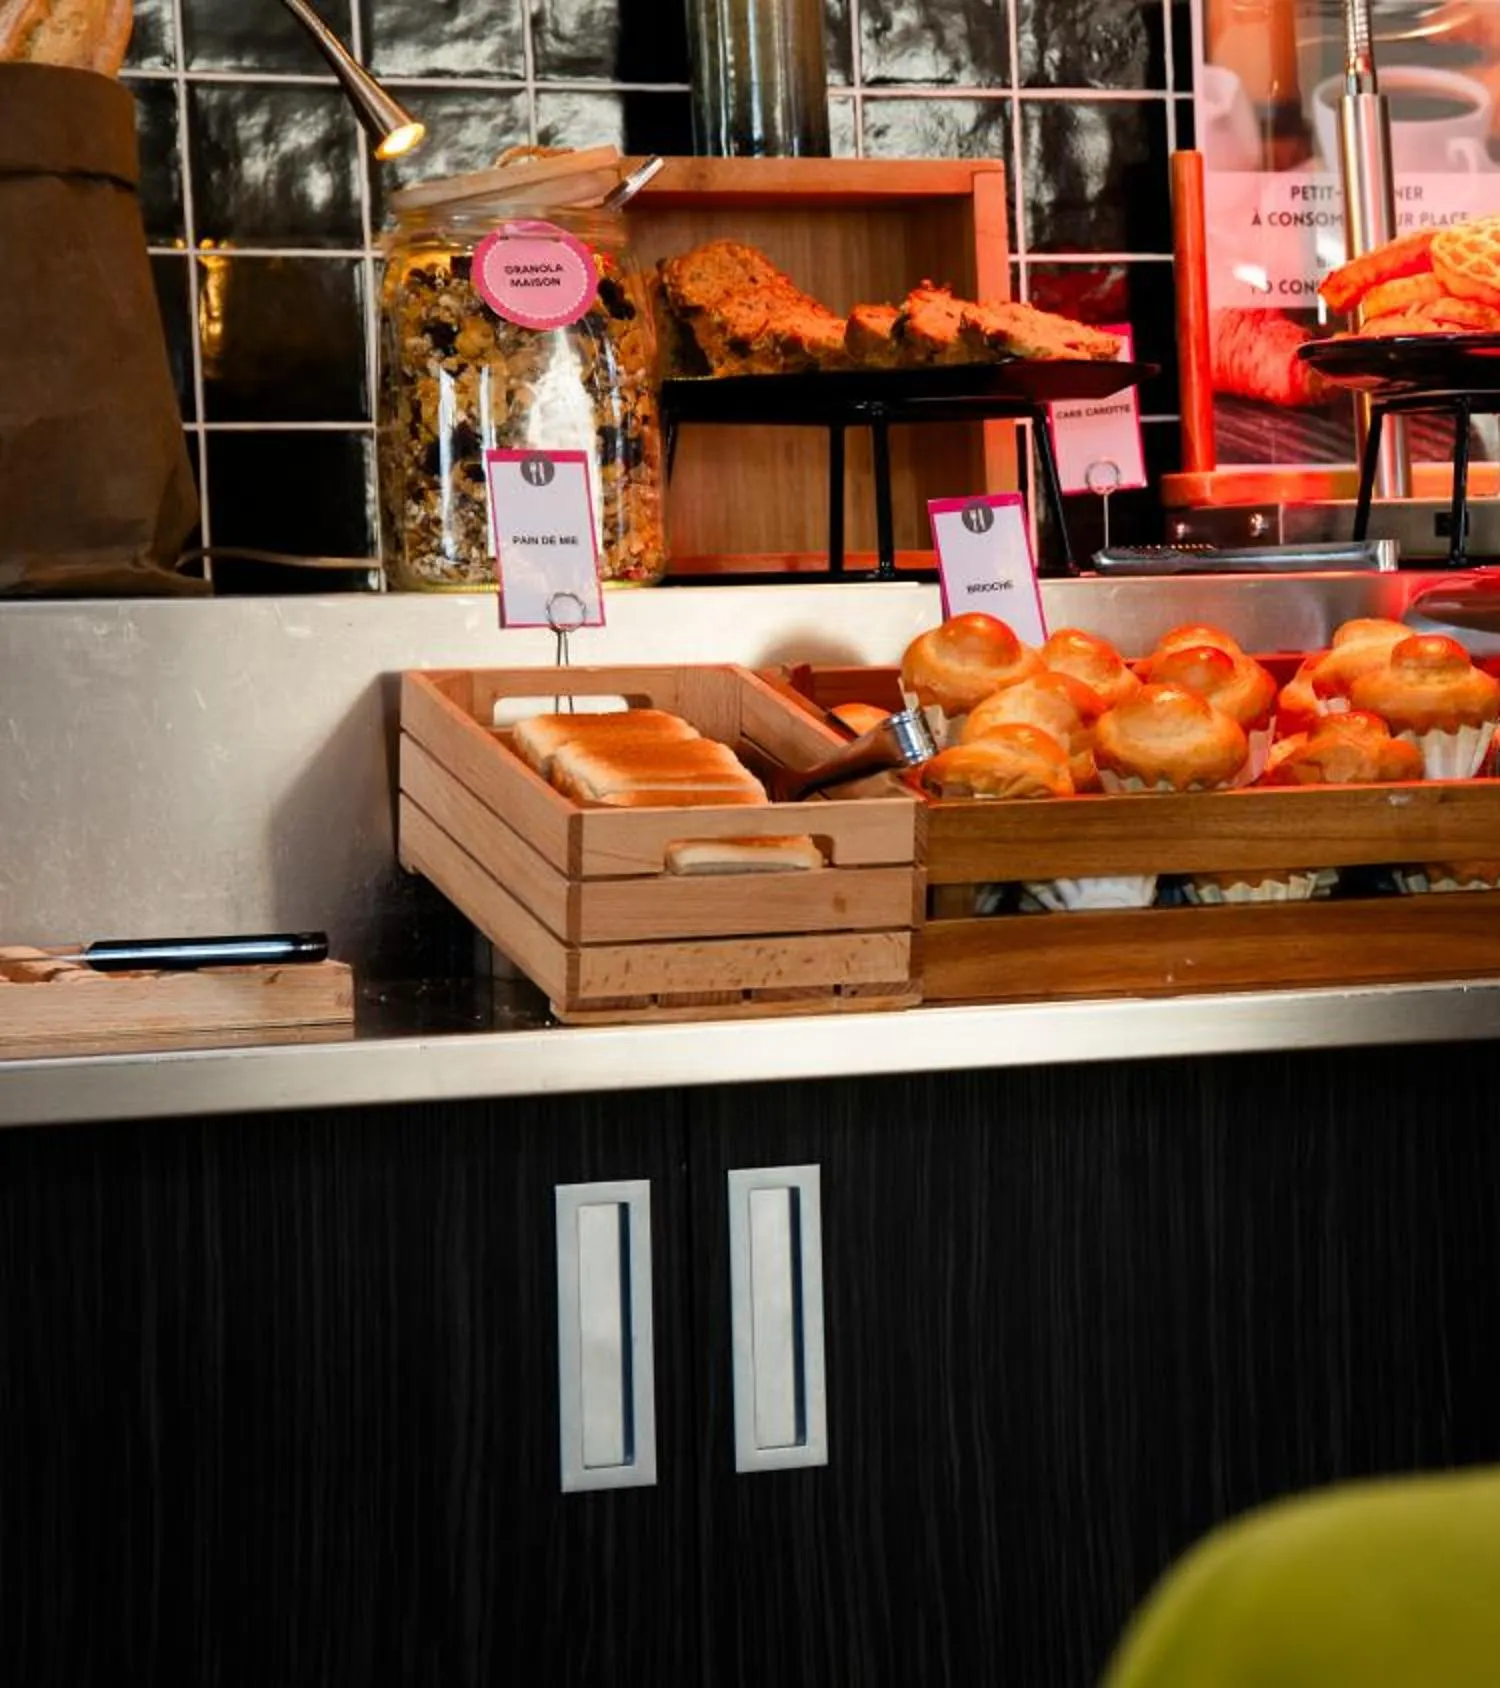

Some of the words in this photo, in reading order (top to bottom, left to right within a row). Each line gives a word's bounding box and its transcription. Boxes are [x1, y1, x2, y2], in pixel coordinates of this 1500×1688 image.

[1252, 205, 1262, 226] À
[504, 263, 564, 275] GRANOLA
[510, 277, 561, 287] MAISON
[1056, 409, 1082, 419] CAKE
[1085, 404, 1131, 417] CAROTTE
[512, 535, 539, 545] PAIN
[541, 535, 556, 545] DE
[559, 535, 578, 545] MIE
[966, 579, 1014, 594] BRIOCHE
